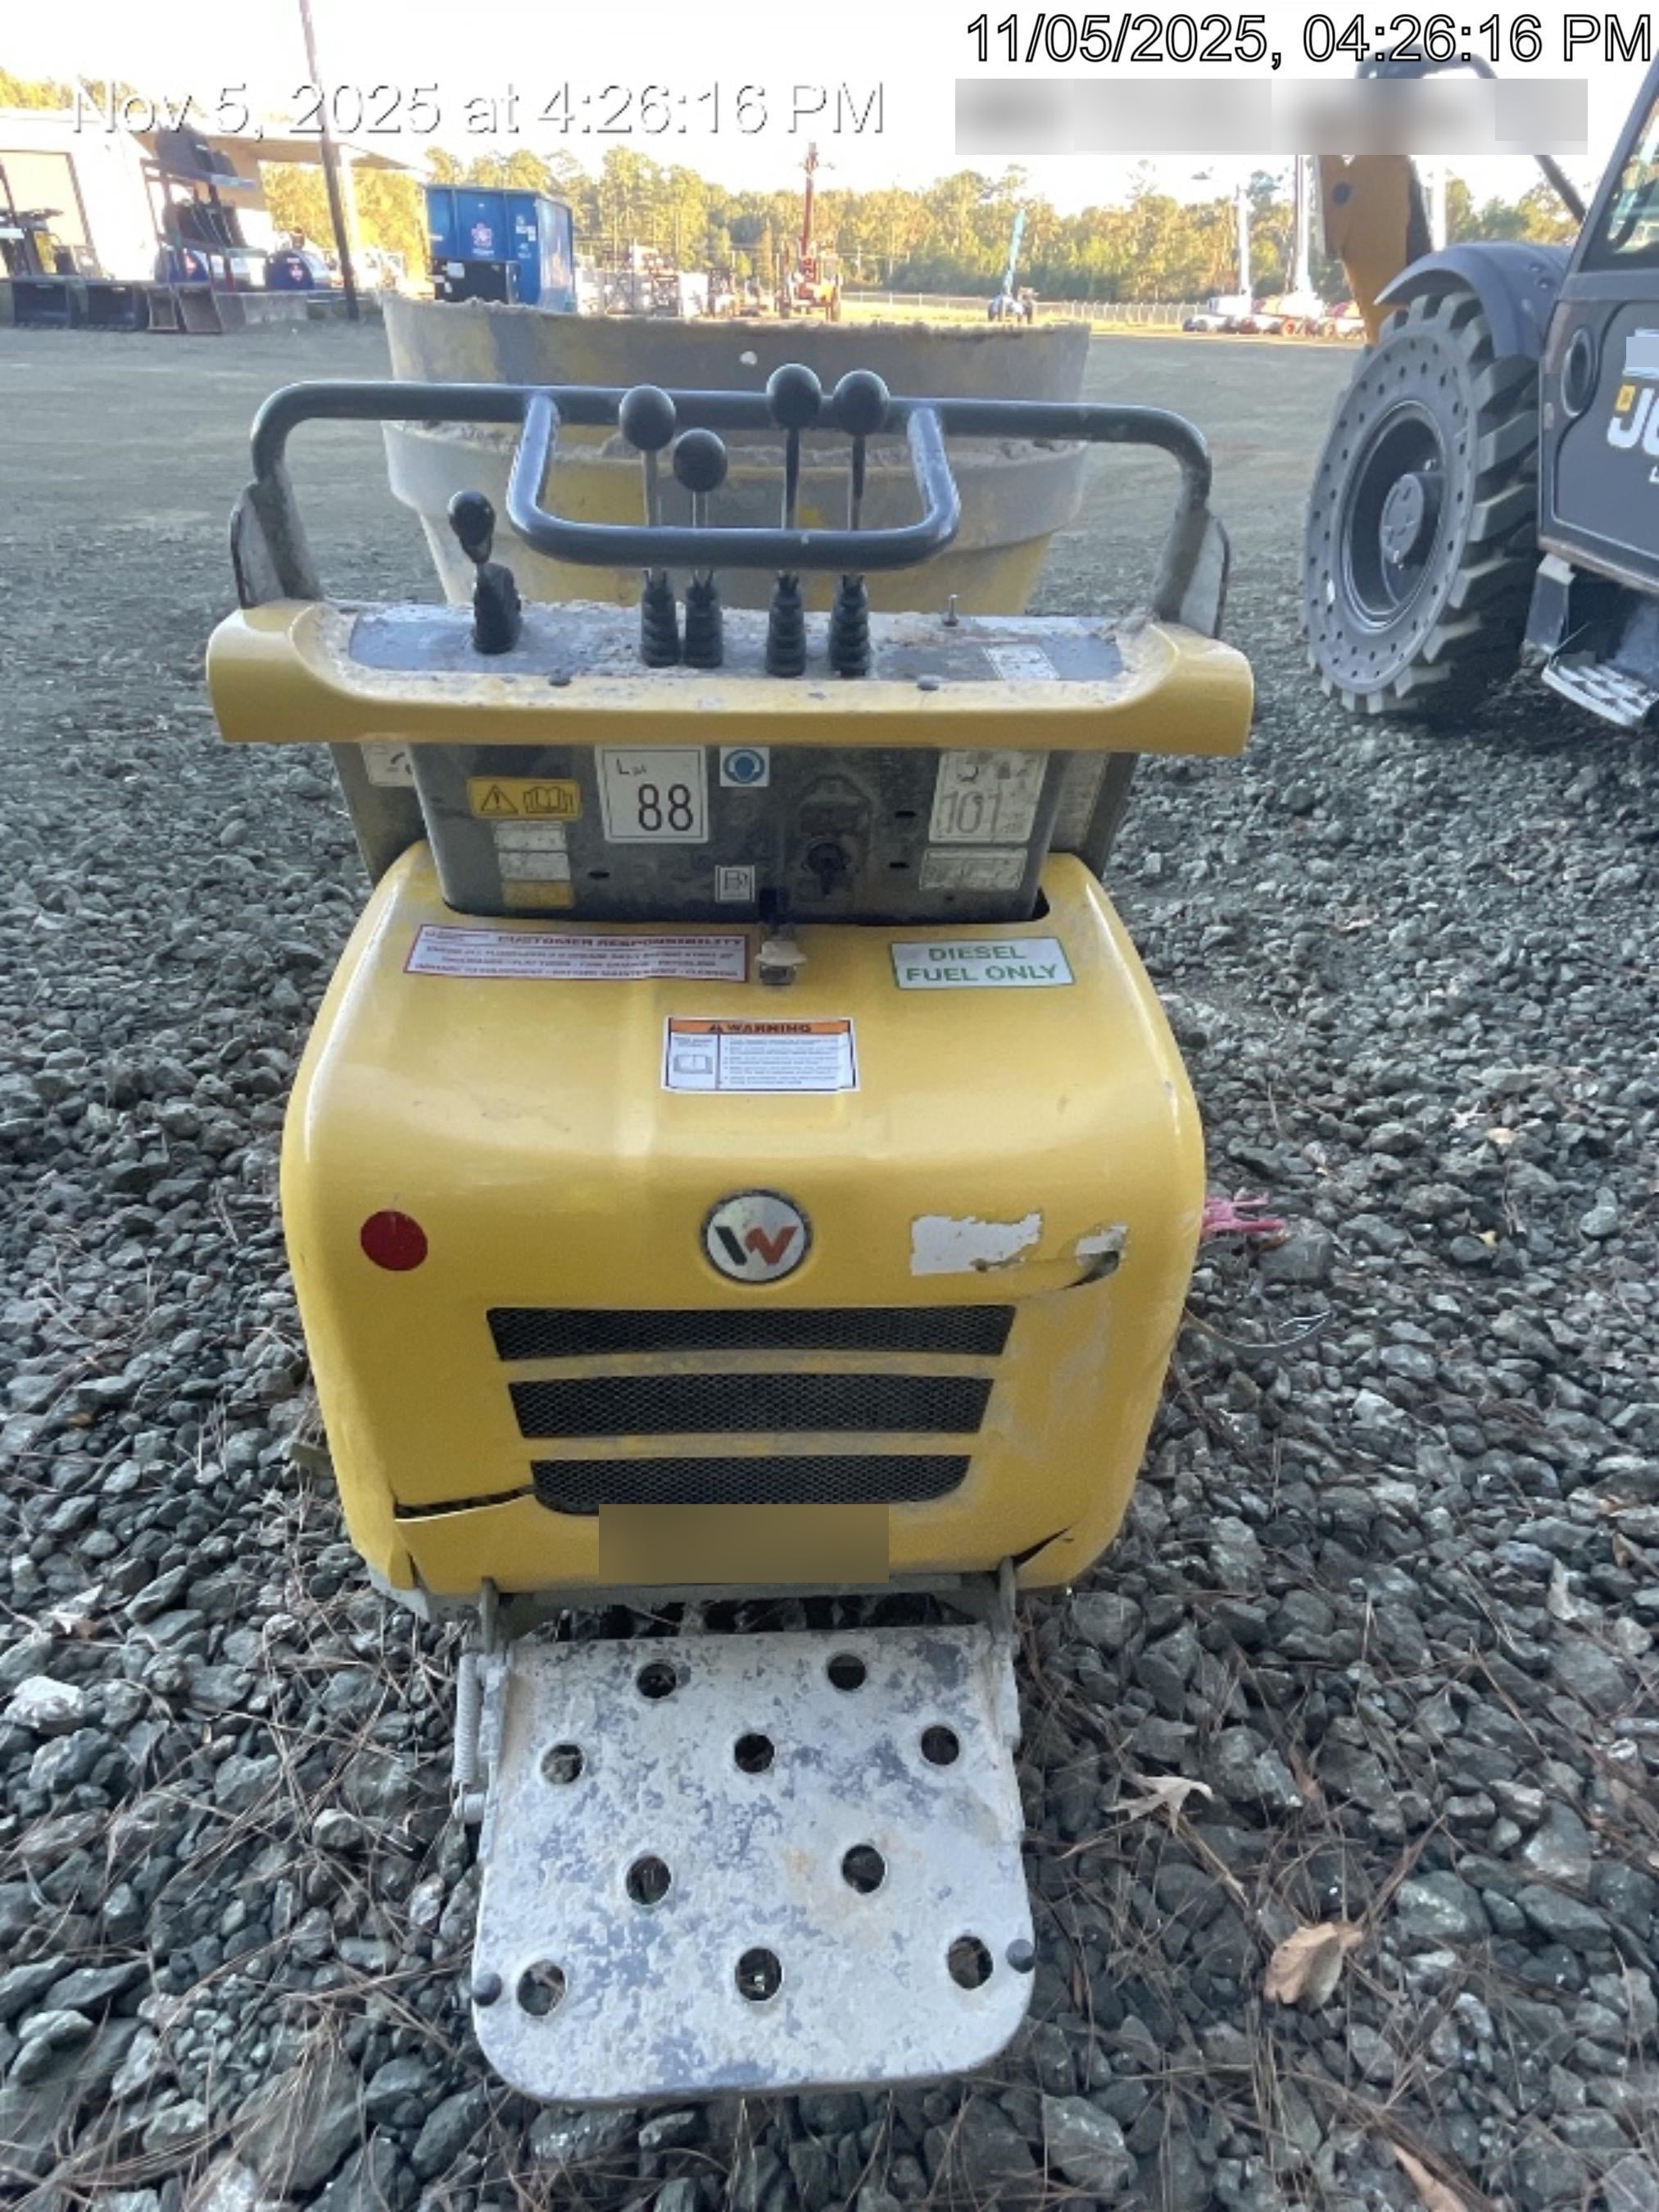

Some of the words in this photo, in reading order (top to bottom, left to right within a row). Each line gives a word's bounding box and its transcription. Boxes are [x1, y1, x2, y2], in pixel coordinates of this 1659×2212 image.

[638, 783, 693, 832] 88
[942, 790, 1000, 837] 101
[928, 945, 1027, 961] DIESEL
[906, 968, 978, 981] FUEL
[986, 963, 1057, 981] ONLY
[728, 1023, 812, 1033] WARNING
